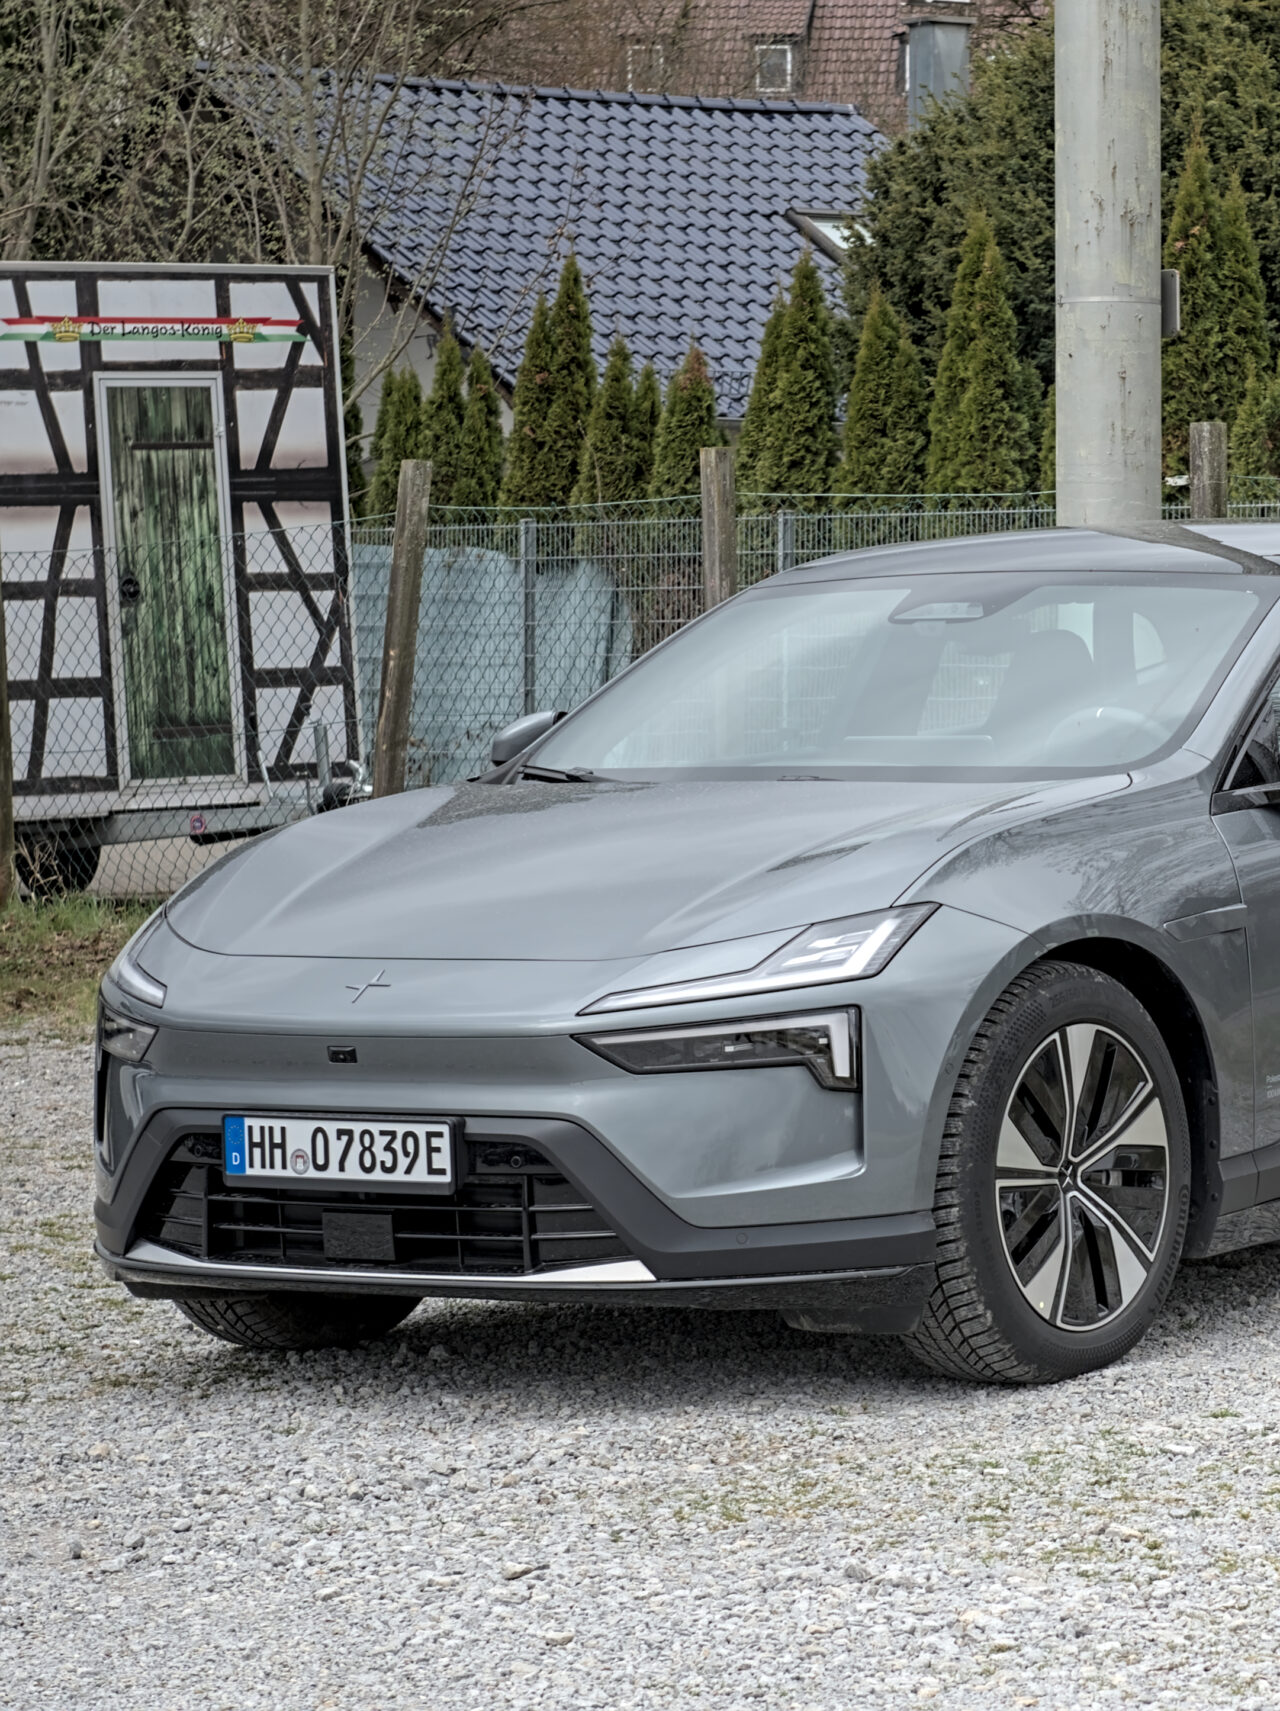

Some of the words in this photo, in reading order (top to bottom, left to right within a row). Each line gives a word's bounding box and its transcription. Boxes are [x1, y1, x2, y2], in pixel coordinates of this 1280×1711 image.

[87, 321, 116, 336] Der
[121, 320, 223, 338] Langos-König
[247, 1125, 287, 1170] HH
[232, 1152, 240, 1165] D
